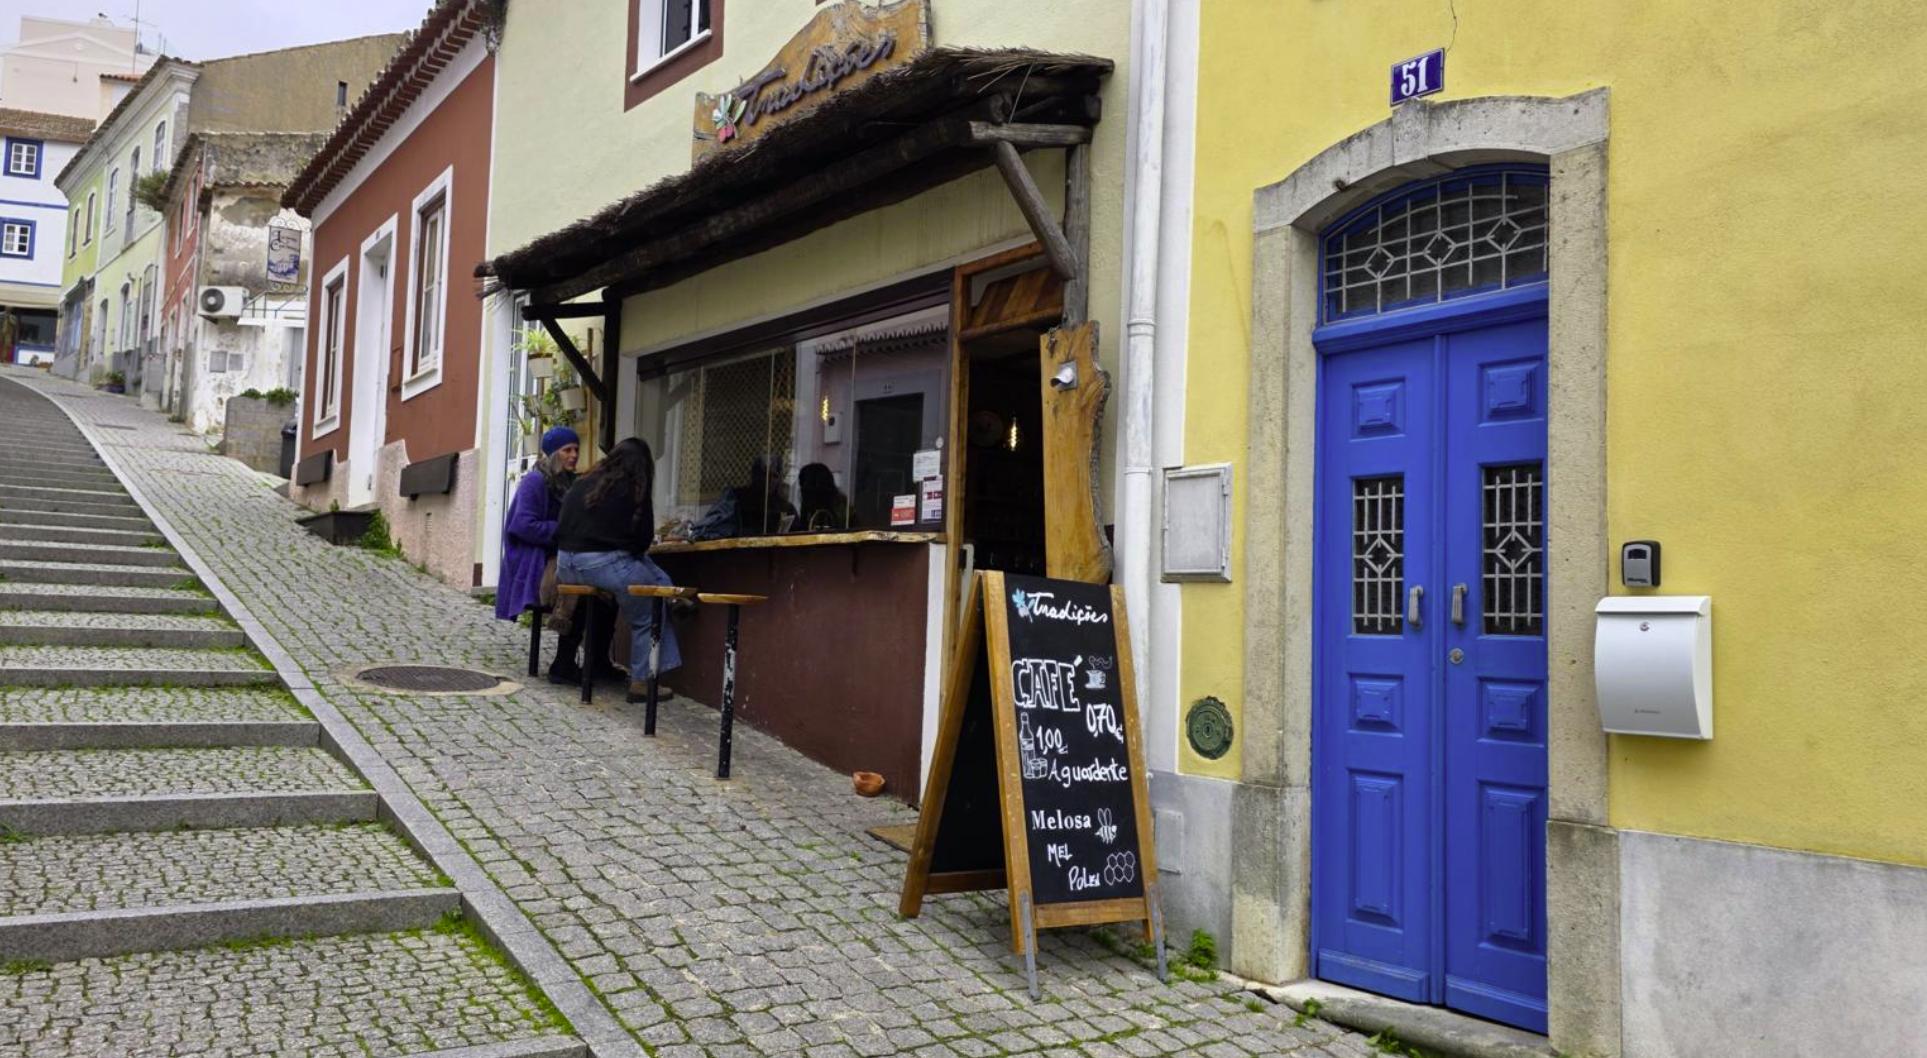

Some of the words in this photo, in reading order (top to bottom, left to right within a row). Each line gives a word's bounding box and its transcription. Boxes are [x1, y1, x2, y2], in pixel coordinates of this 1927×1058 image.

[1401, 56, 1429, 97] 51
[1026, 592, 1108, 626] Tradições
[1011, 655, 1083, 712] CAFÉ
[1048, 757, 1128, 788] Aguardente
[1031, 809, 1092, 830] Melosa
